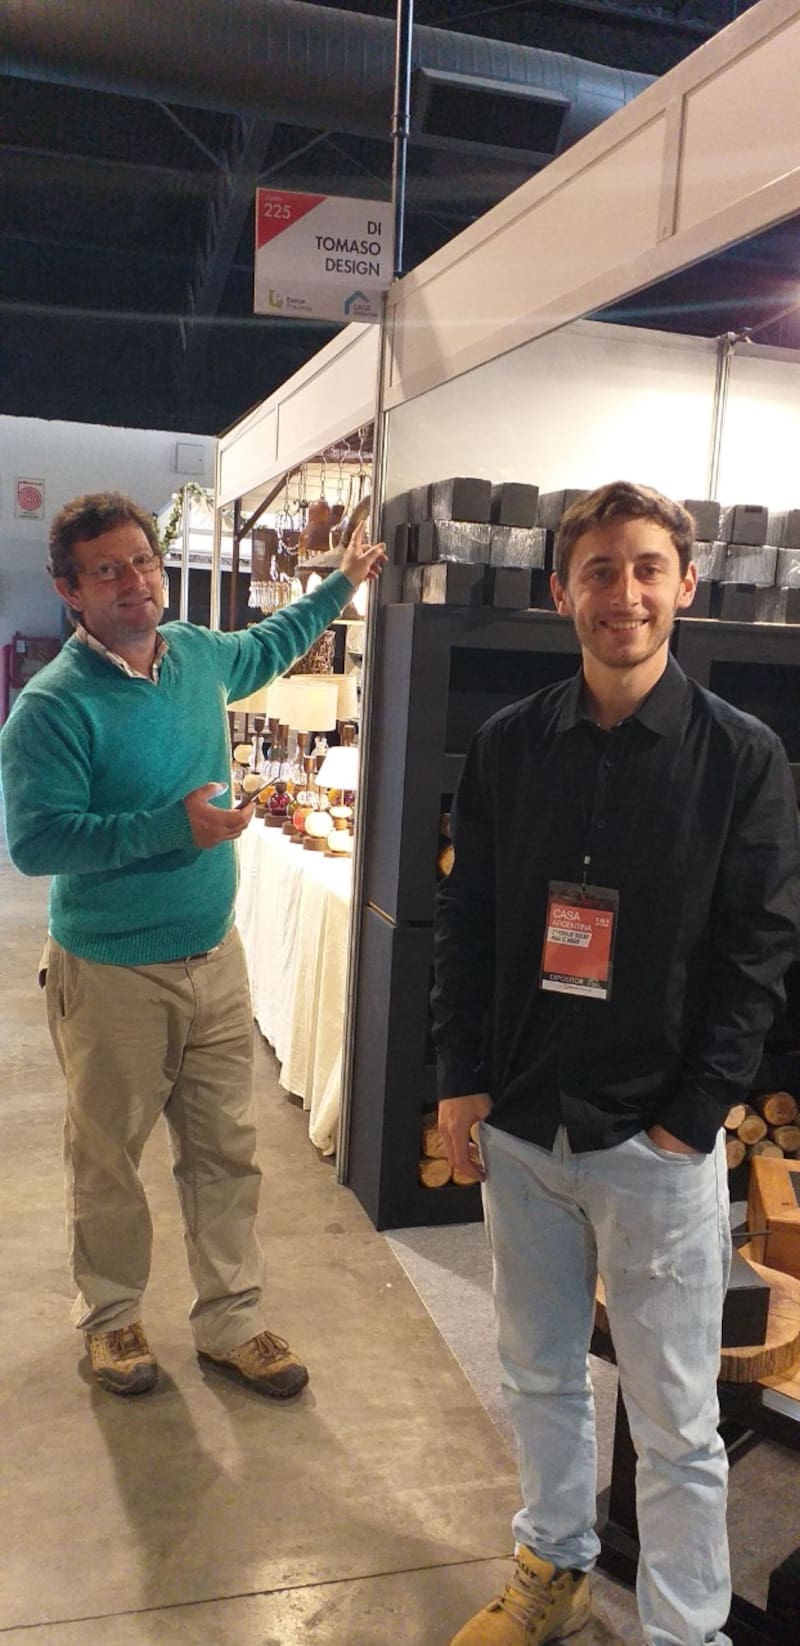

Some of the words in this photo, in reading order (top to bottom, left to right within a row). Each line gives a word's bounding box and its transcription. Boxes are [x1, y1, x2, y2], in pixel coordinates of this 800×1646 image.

[264, 203, 291, 219] 225
[367, 221, 381, 236] DI
[315, 236, 381, 256] TOMASO
[325, 258, 380, 276] DESIGN
[553, 909, 581, 921] CASA
[552, 920, 593, 932] ARGENTINA
